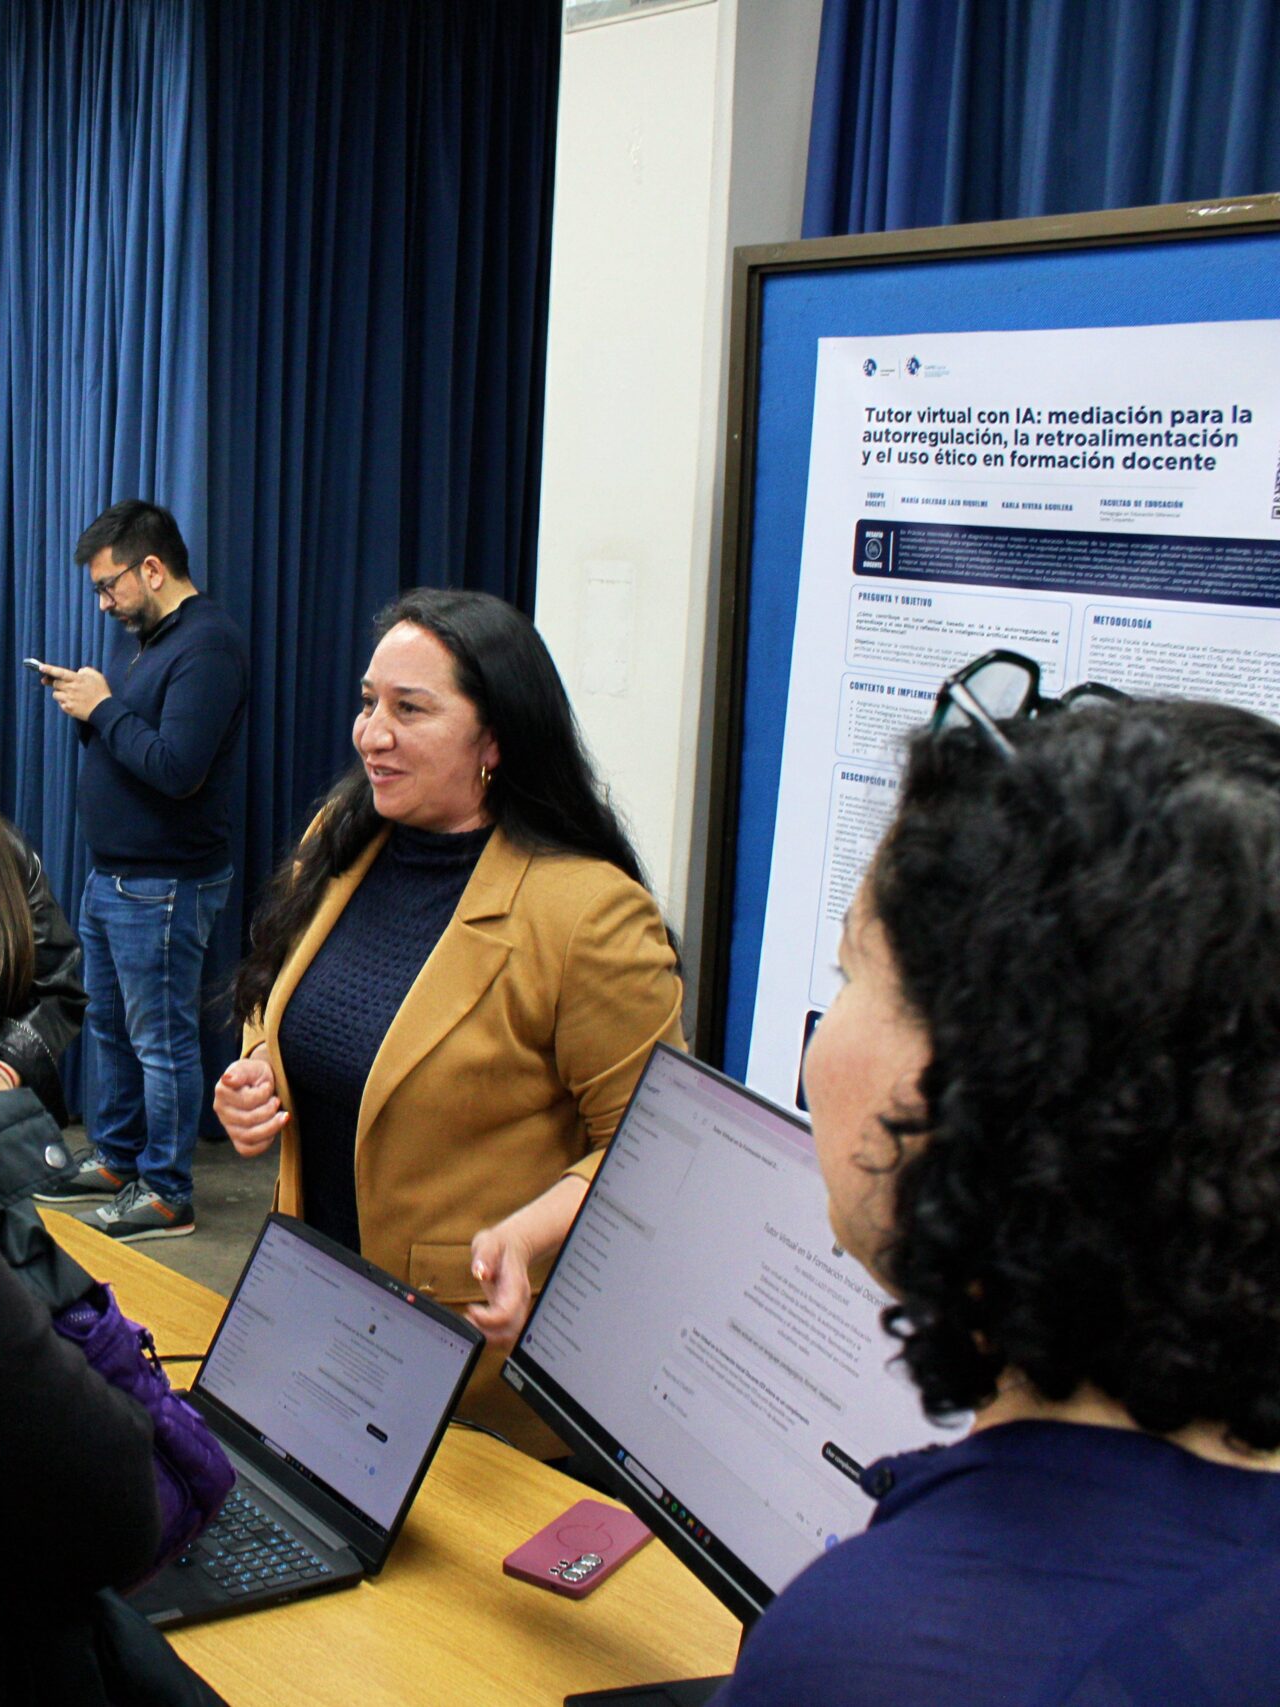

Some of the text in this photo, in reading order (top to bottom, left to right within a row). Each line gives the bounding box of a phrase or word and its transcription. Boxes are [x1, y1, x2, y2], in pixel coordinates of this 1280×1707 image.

[865, 404, 1252, 428] Tutor virtual con IA: mediación para la
[862, 426, 1238, 449] autorregulación, la retroalimentación
[862, 448, 1217, 471] y el uso ético en formación docente
[858, 592, 932, 608] PREGUNTA Y OBJETIVO
[1093, 616, 1152, 630] METODOLOGÍA
[850, 681, 940, 701] CONTEXTO DE IMPLEMENT
[840, 771, 886, 787] DESCRIPCIÓN
